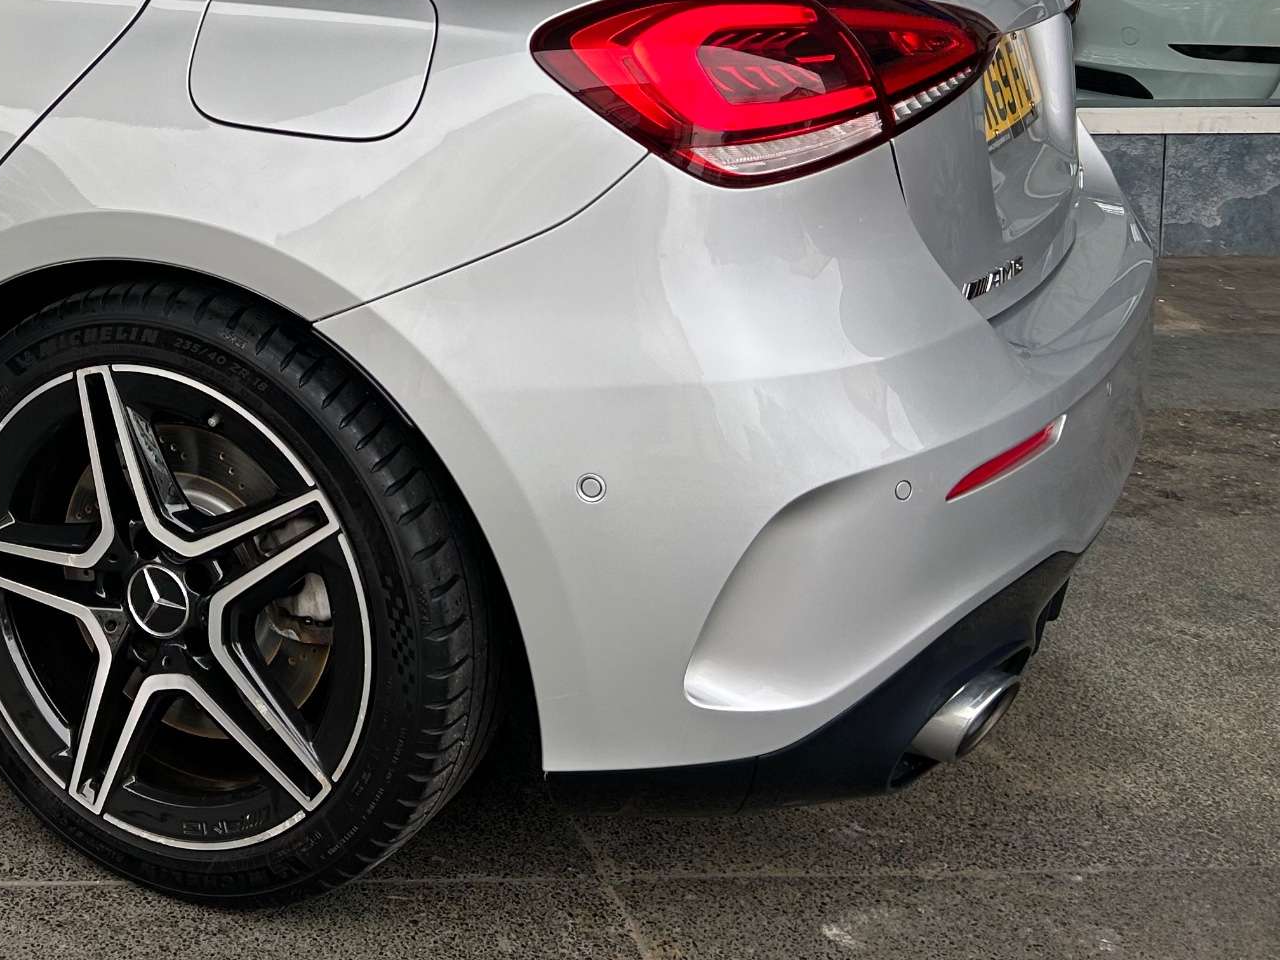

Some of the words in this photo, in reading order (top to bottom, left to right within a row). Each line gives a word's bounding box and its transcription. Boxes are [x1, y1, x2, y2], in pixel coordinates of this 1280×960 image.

[174, 338, 227, 365] 235/40
[230, 362, 251, 379] ZR
[252, 377, 270, 392] 18
